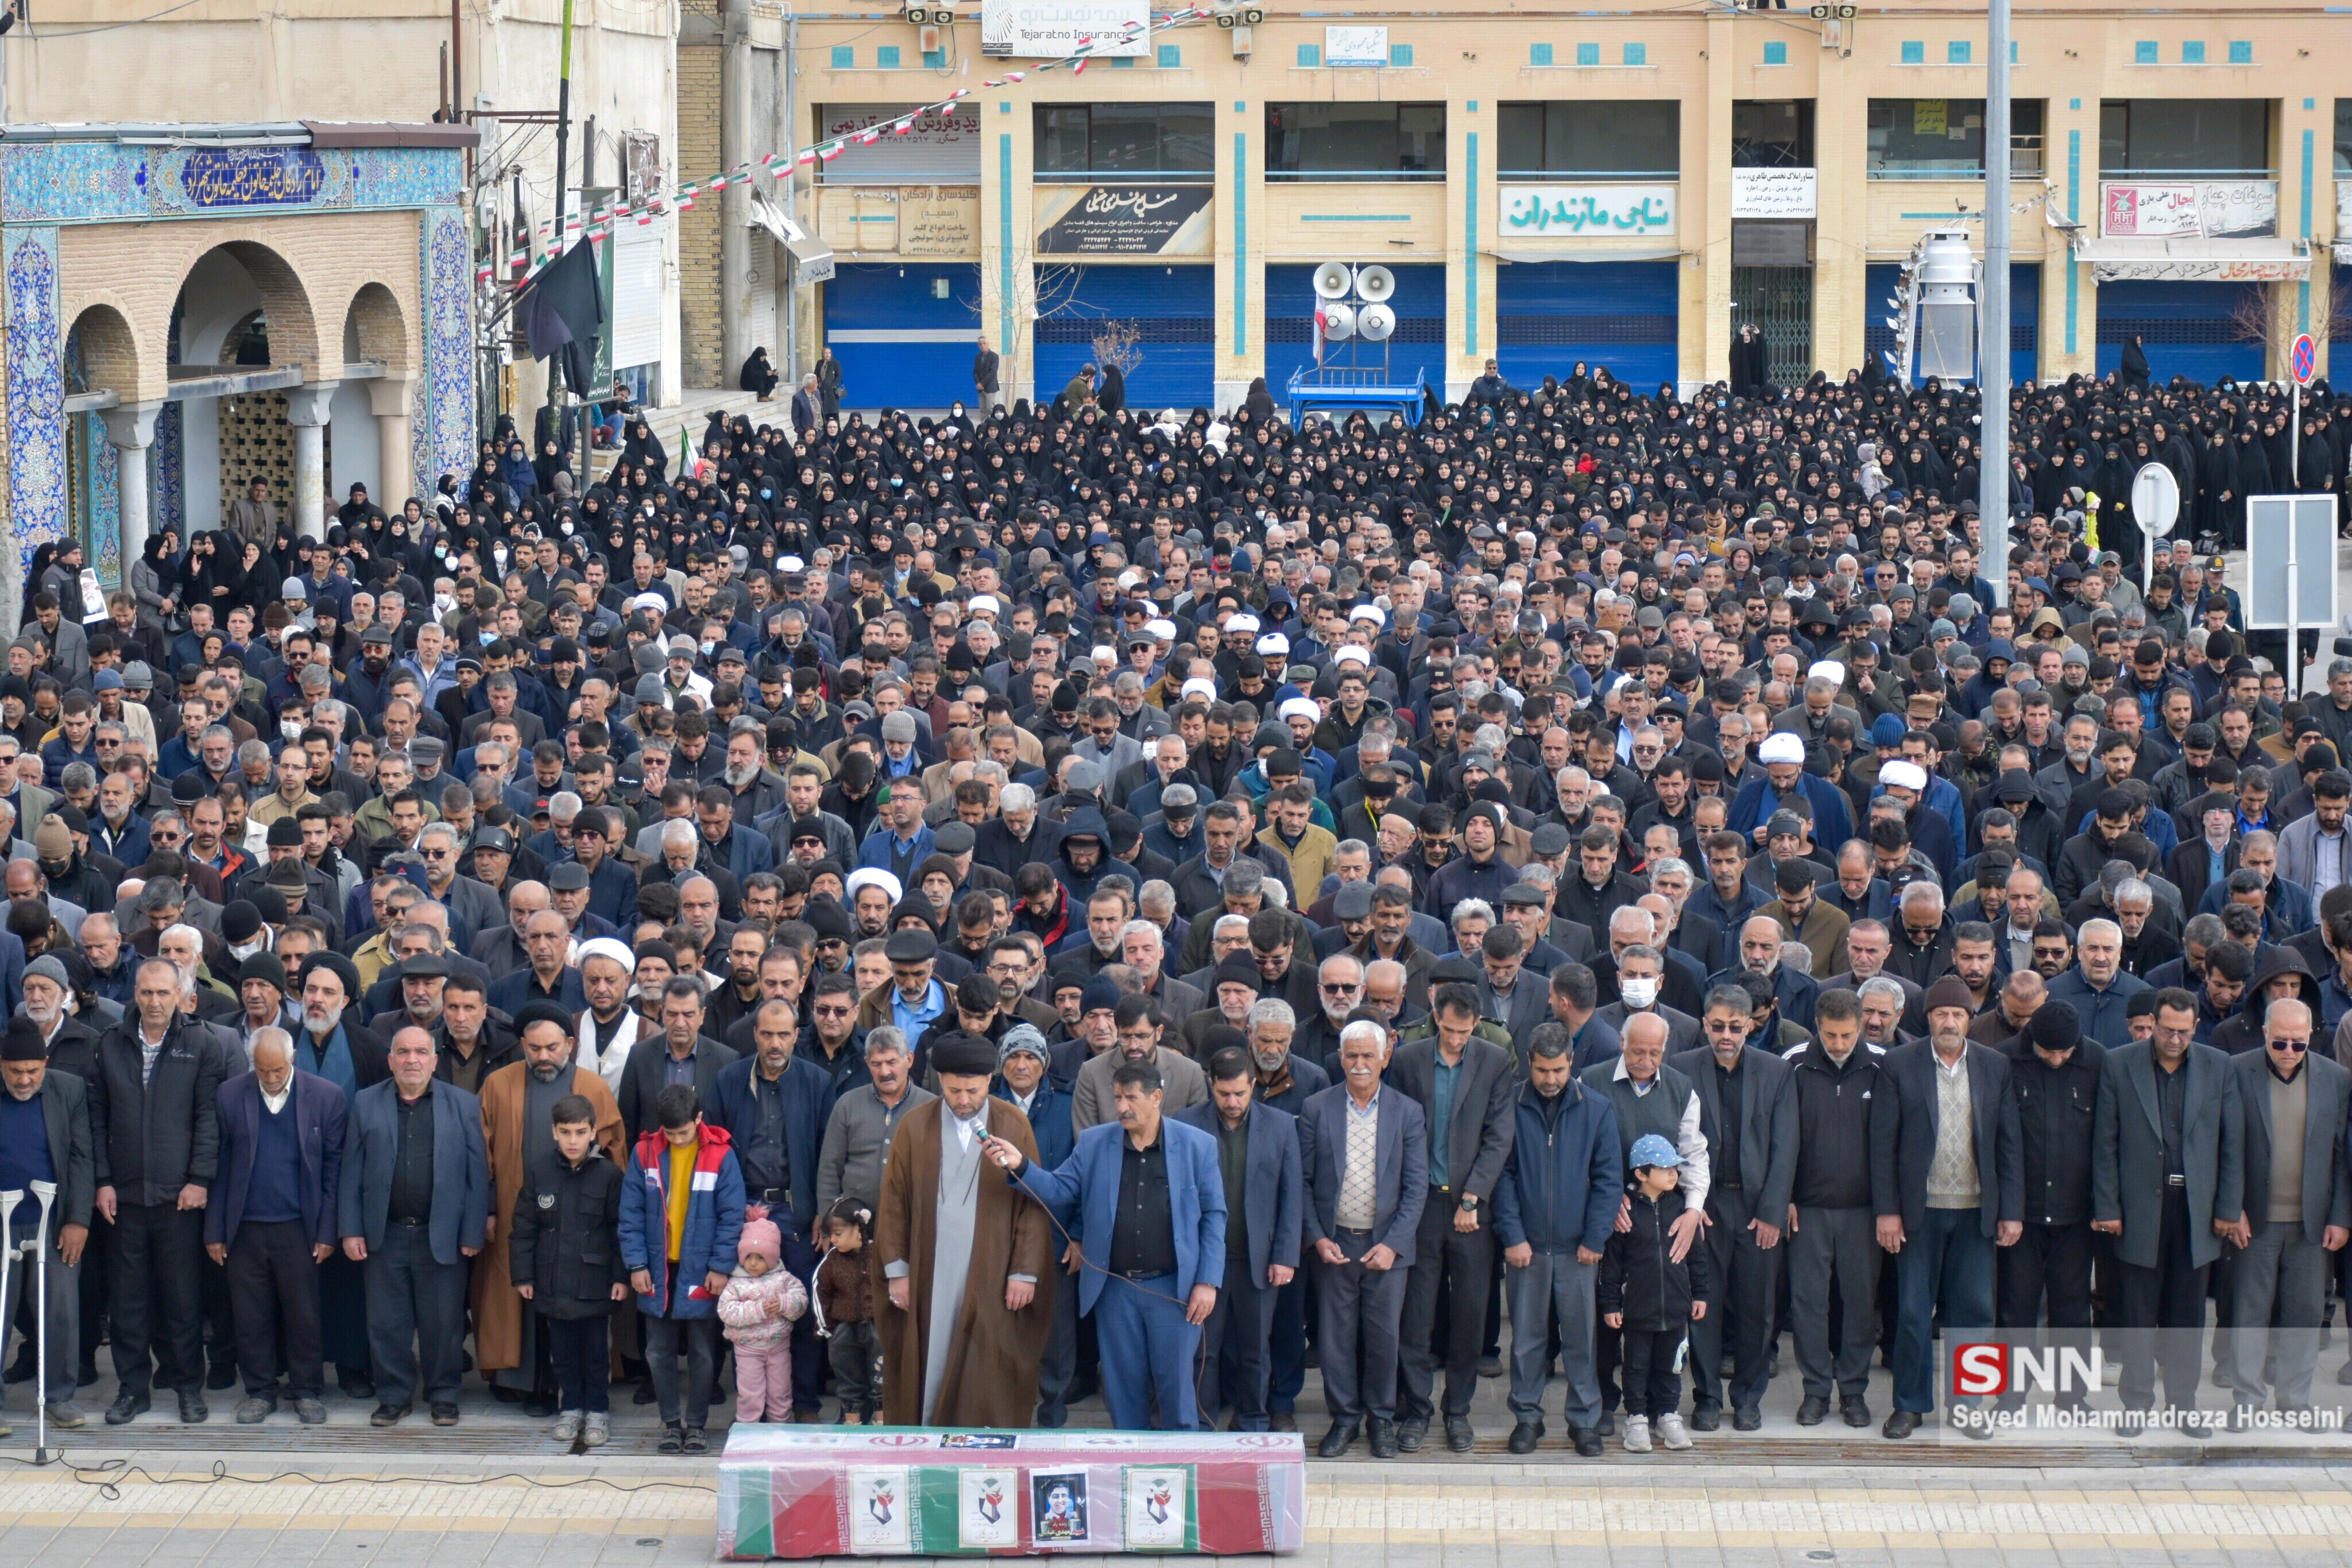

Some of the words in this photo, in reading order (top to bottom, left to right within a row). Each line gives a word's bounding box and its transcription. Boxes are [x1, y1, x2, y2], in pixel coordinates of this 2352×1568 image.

[1020, 29, 1070, 41] Tejaratno
[1073, 29, 1127, 39] Insurance
[936, 189, 977, 201] کلیدسازی
[1134, 192, 1178, 218] صنایع
[2231, 185, 2273, 210] سوغات
[1510, 195, 1608, 232] مازندران
[1613, 196, 1669, 234] نساجی
[2152, 262, 2176, 278] عسل
